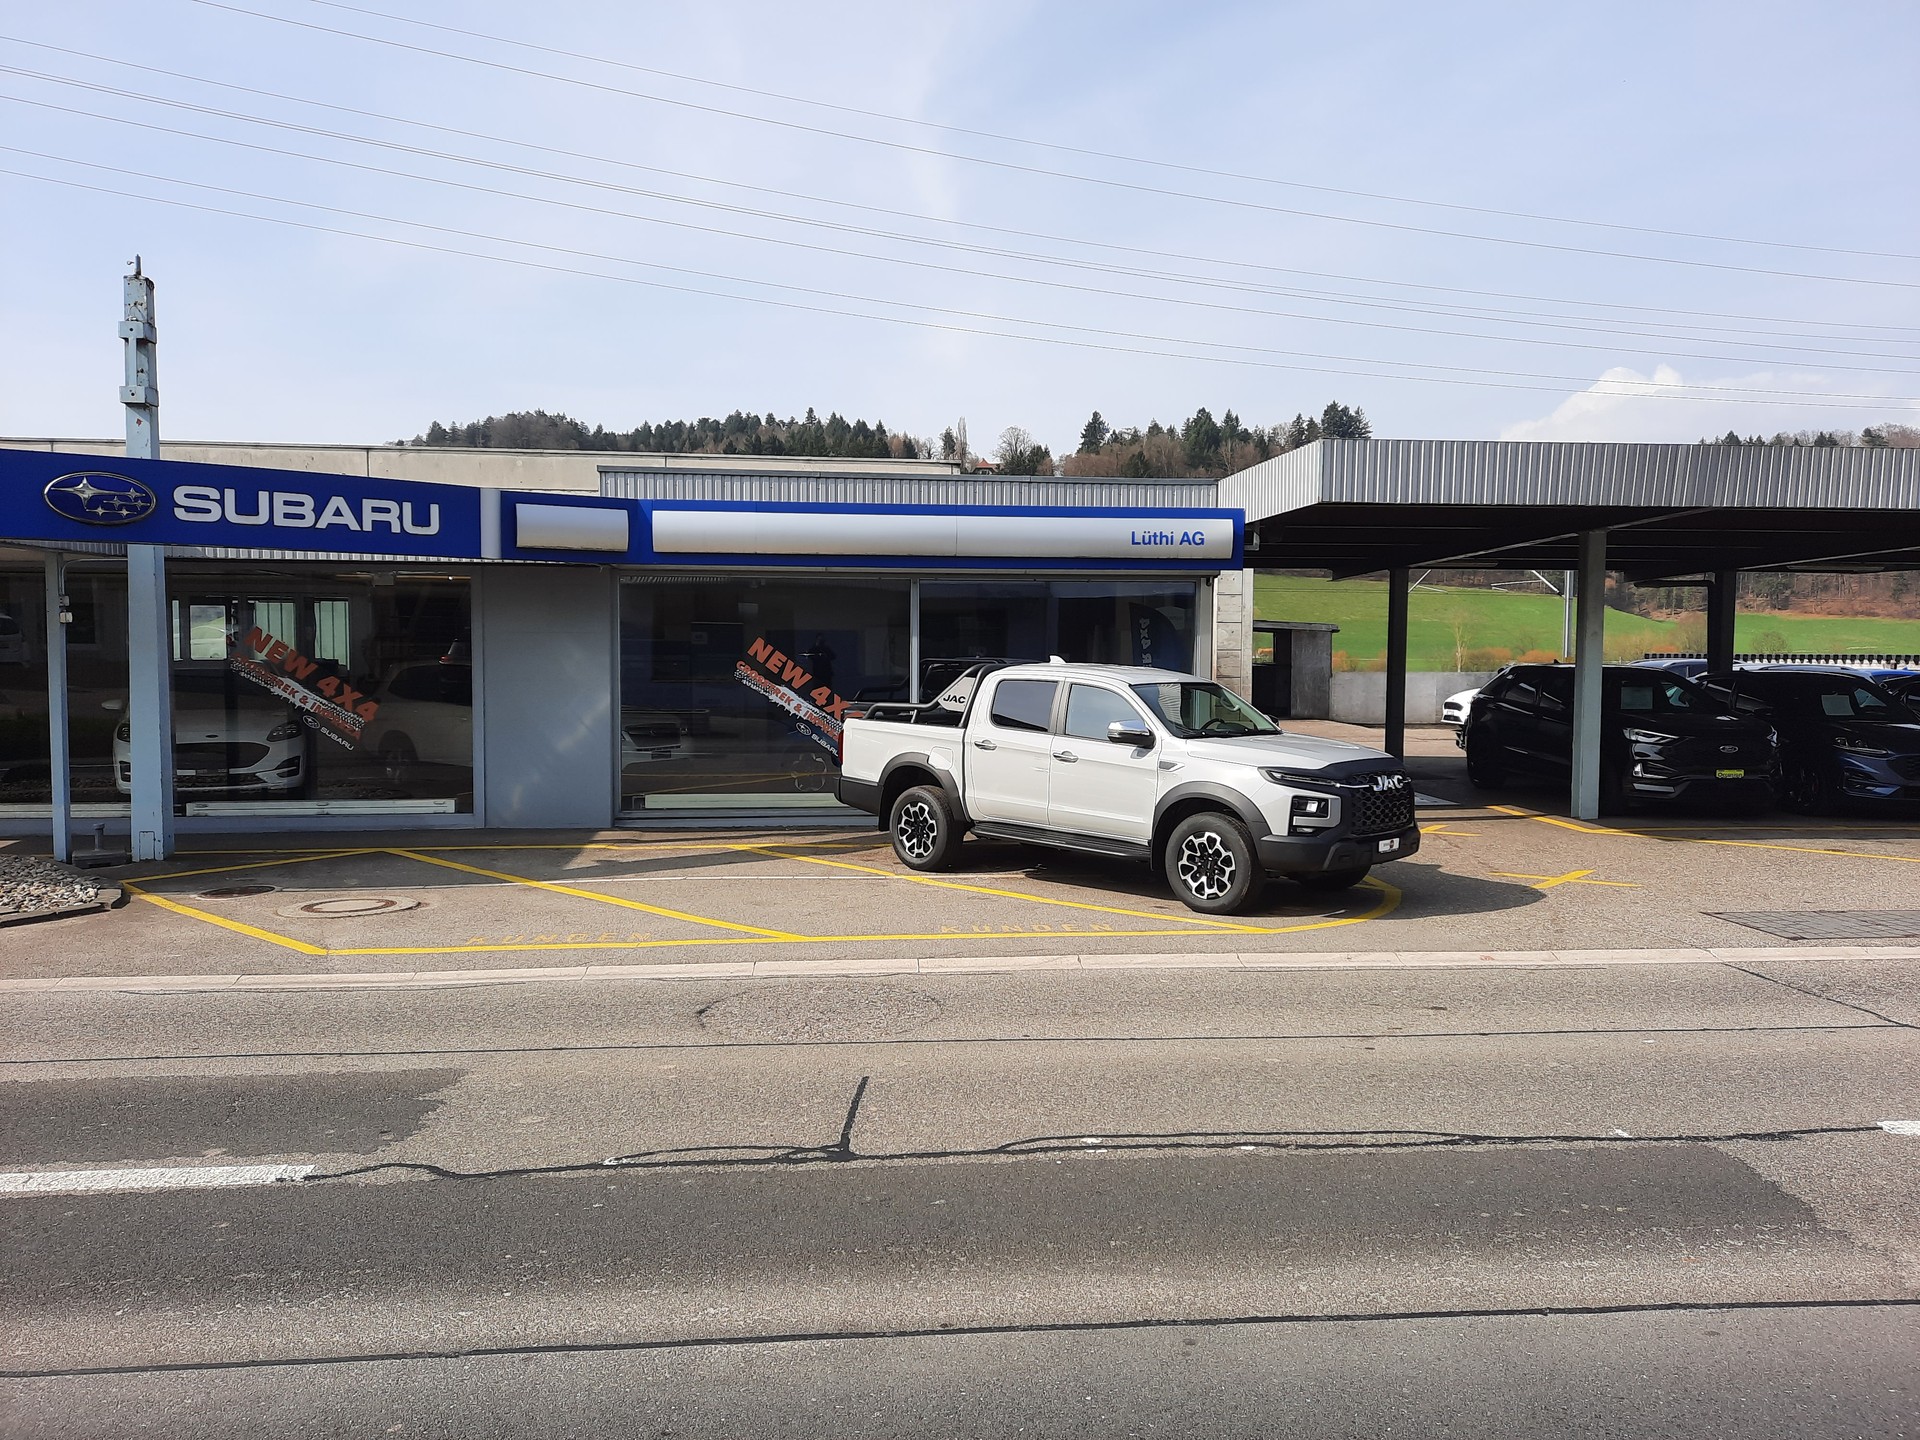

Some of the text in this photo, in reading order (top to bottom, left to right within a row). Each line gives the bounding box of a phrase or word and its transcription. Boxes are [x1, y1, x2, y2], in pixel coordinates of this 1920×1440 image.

[173, 485, 440, 535] SUBARU
[1131, 531, 1205, 545] Lüthi AG
[245, 626, 380, 722] NEW 4X4
[747, 637, 864, 720] NEW 4X
[299, 695, 309, 705] &
[943, 695, 966, 704] JAC
[794, 703, 802, 712] &
[320, 727, 354, 750] SUBARU
[1373, 775, 1404, 791] JAC
[940, 923, 1114, 933] KUNDEN
